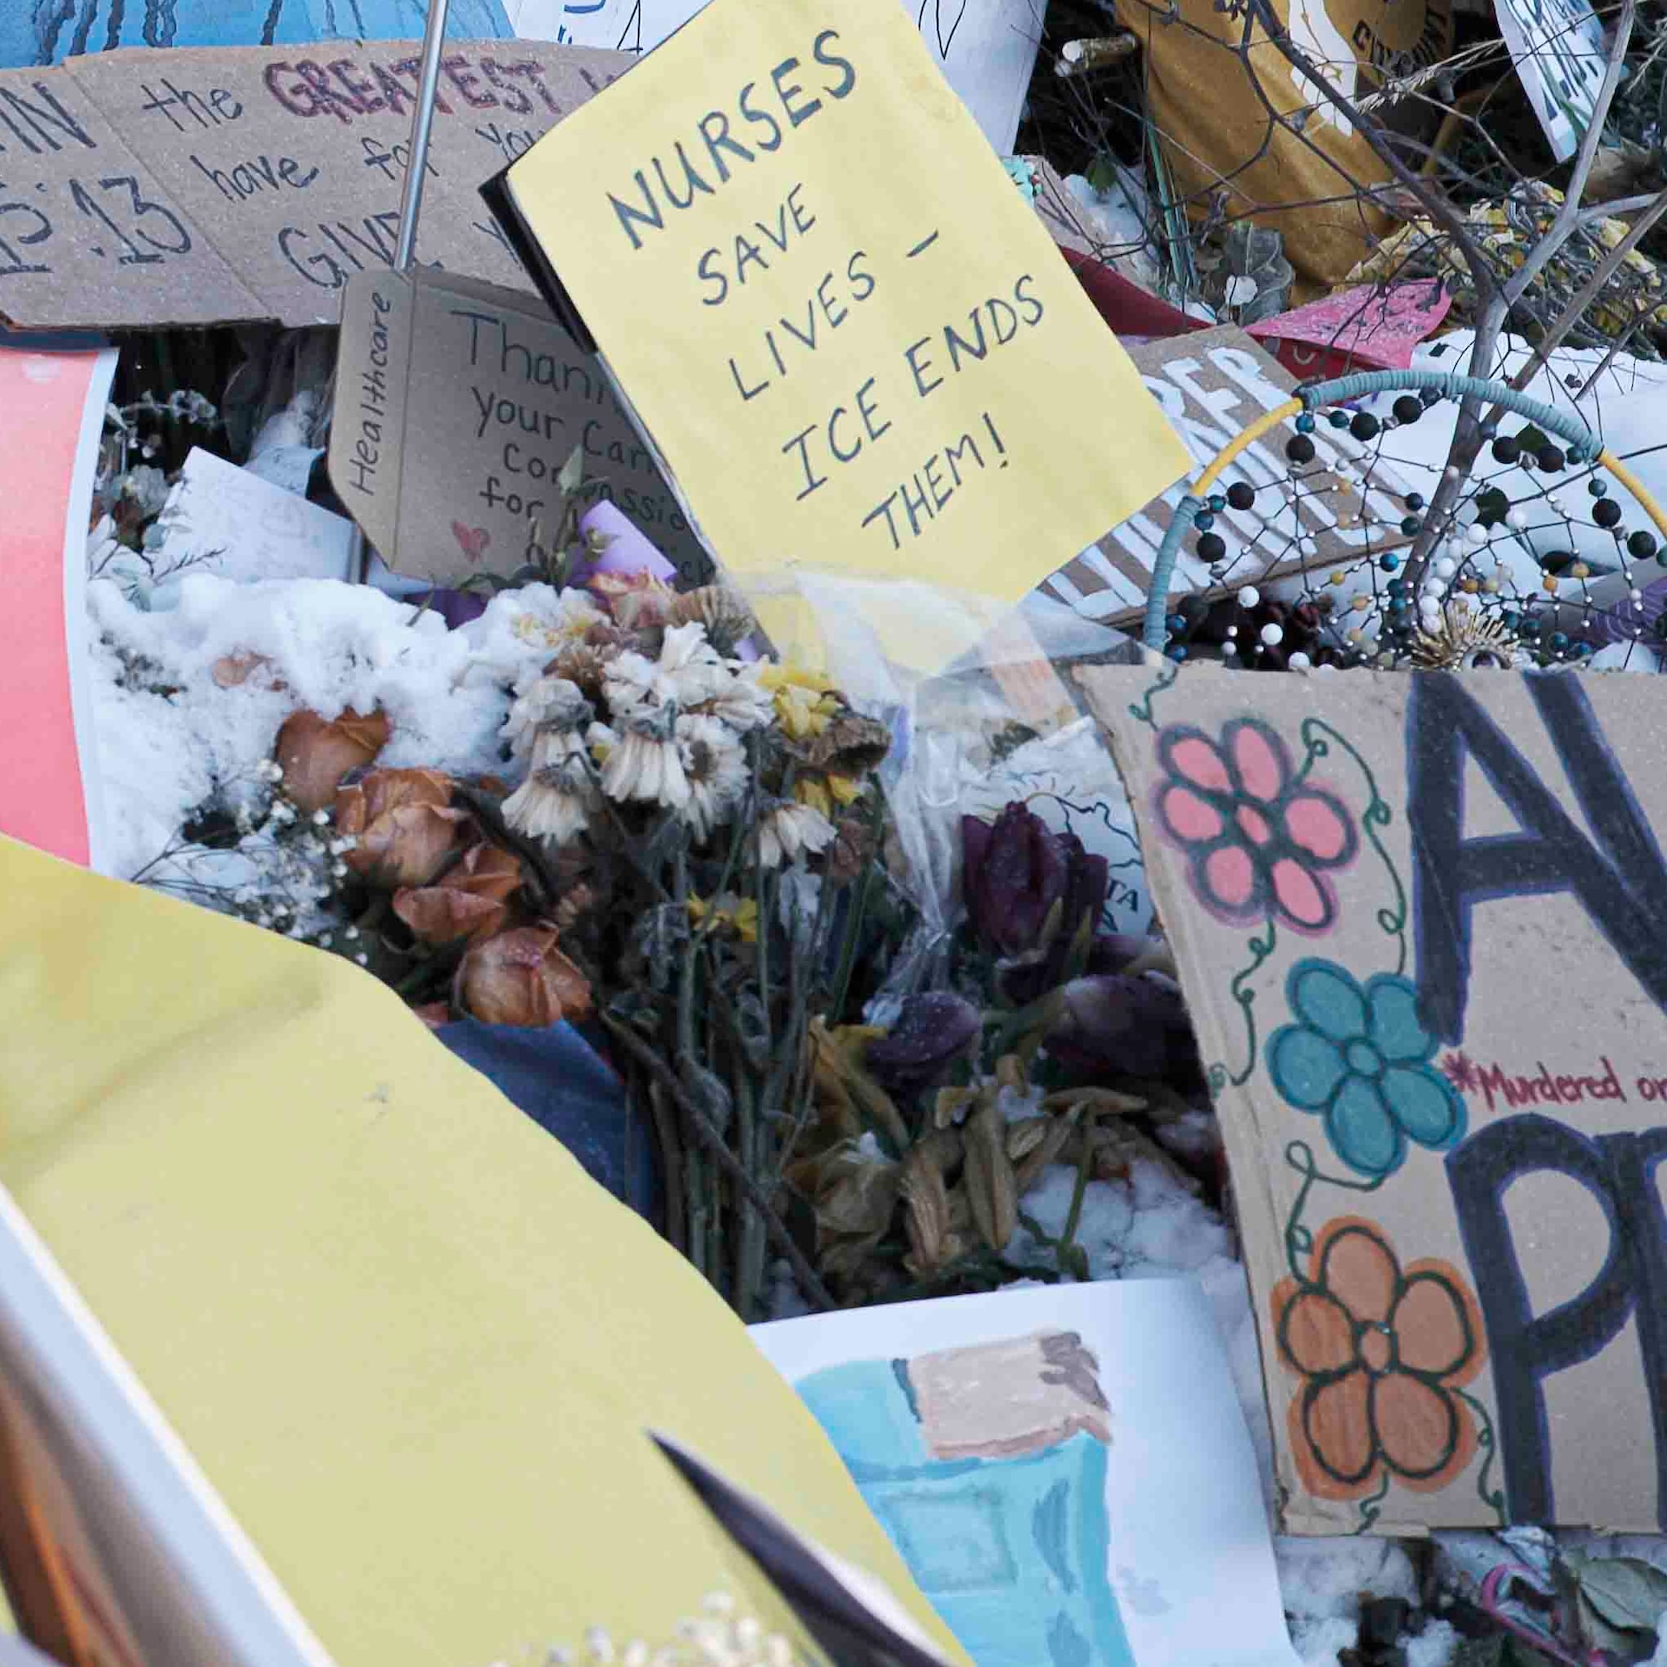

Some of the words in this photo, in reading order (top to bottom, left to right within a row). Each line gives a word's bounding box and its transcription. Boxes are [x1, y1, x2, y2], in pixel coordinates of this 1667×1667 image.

[140, 77, 244, 132] the
[262, 52, 564, 126] GREATEST
[604, 28, 857, 249] NURSES
[189, 154, 320, 204] have
[696, 181, 818, 309] SAVE
[349, 291, 393, 496] Healthcare
[728, 249, 878, 403] LIVES
[782, 382, 896, 504] ICE
[916, 275, 1047, 399] ENDS
[470, 384, 564, 439] your
[478, 476, 545, 518] for
[861, 411, 1012, 553] THEM!
